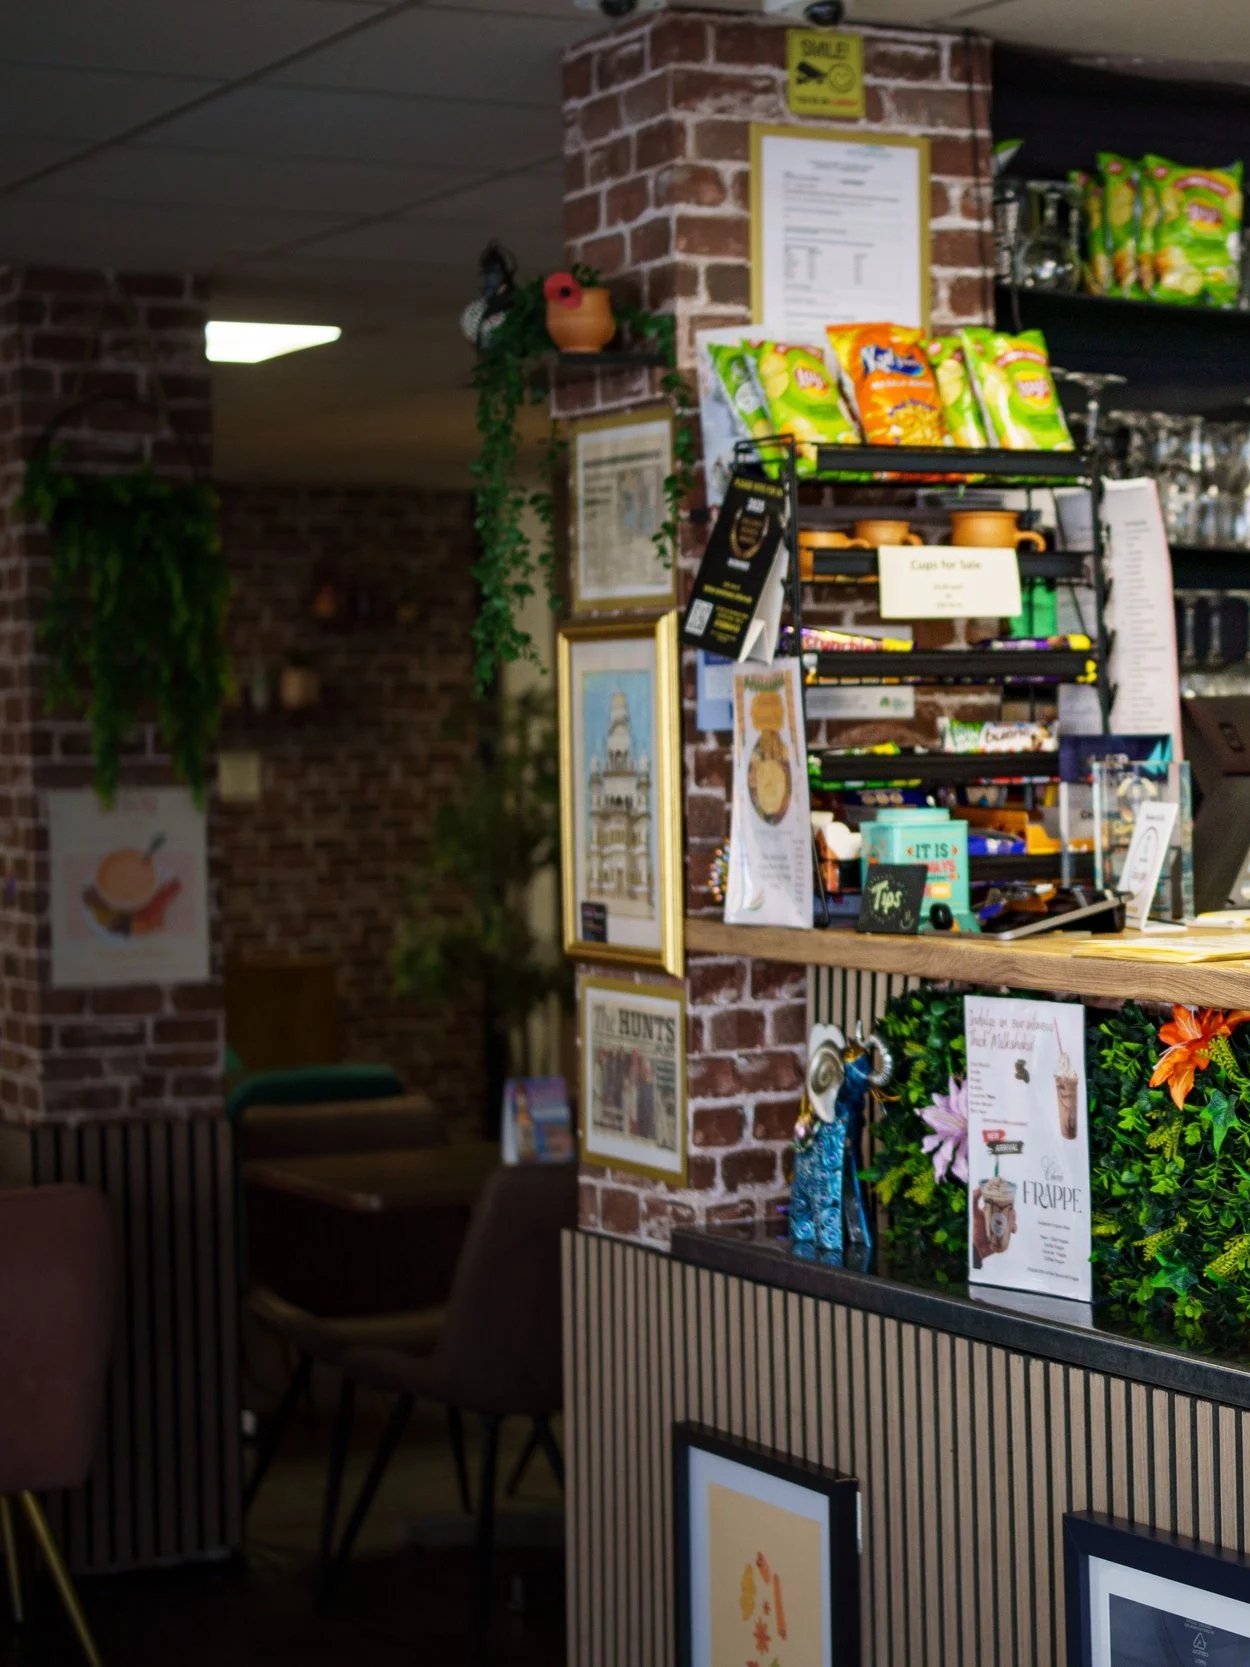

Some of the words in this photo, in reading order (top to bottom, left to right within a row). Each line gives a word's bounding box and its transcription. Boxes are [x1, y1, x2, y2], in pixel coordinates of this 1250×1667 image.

[801, 39, 849, 60] SMILE!
[910, 559, 937, 573] Cups
[942, 559, 956, 570] for
[915, 843, 931, 859] IT
[935, 842, 949, 858] IS
[870, 880, 903, 915] Tips
[618, 1007, 676, 1044] HUNTS
[995, 1143, 1019, 1153] ARRIVAL
